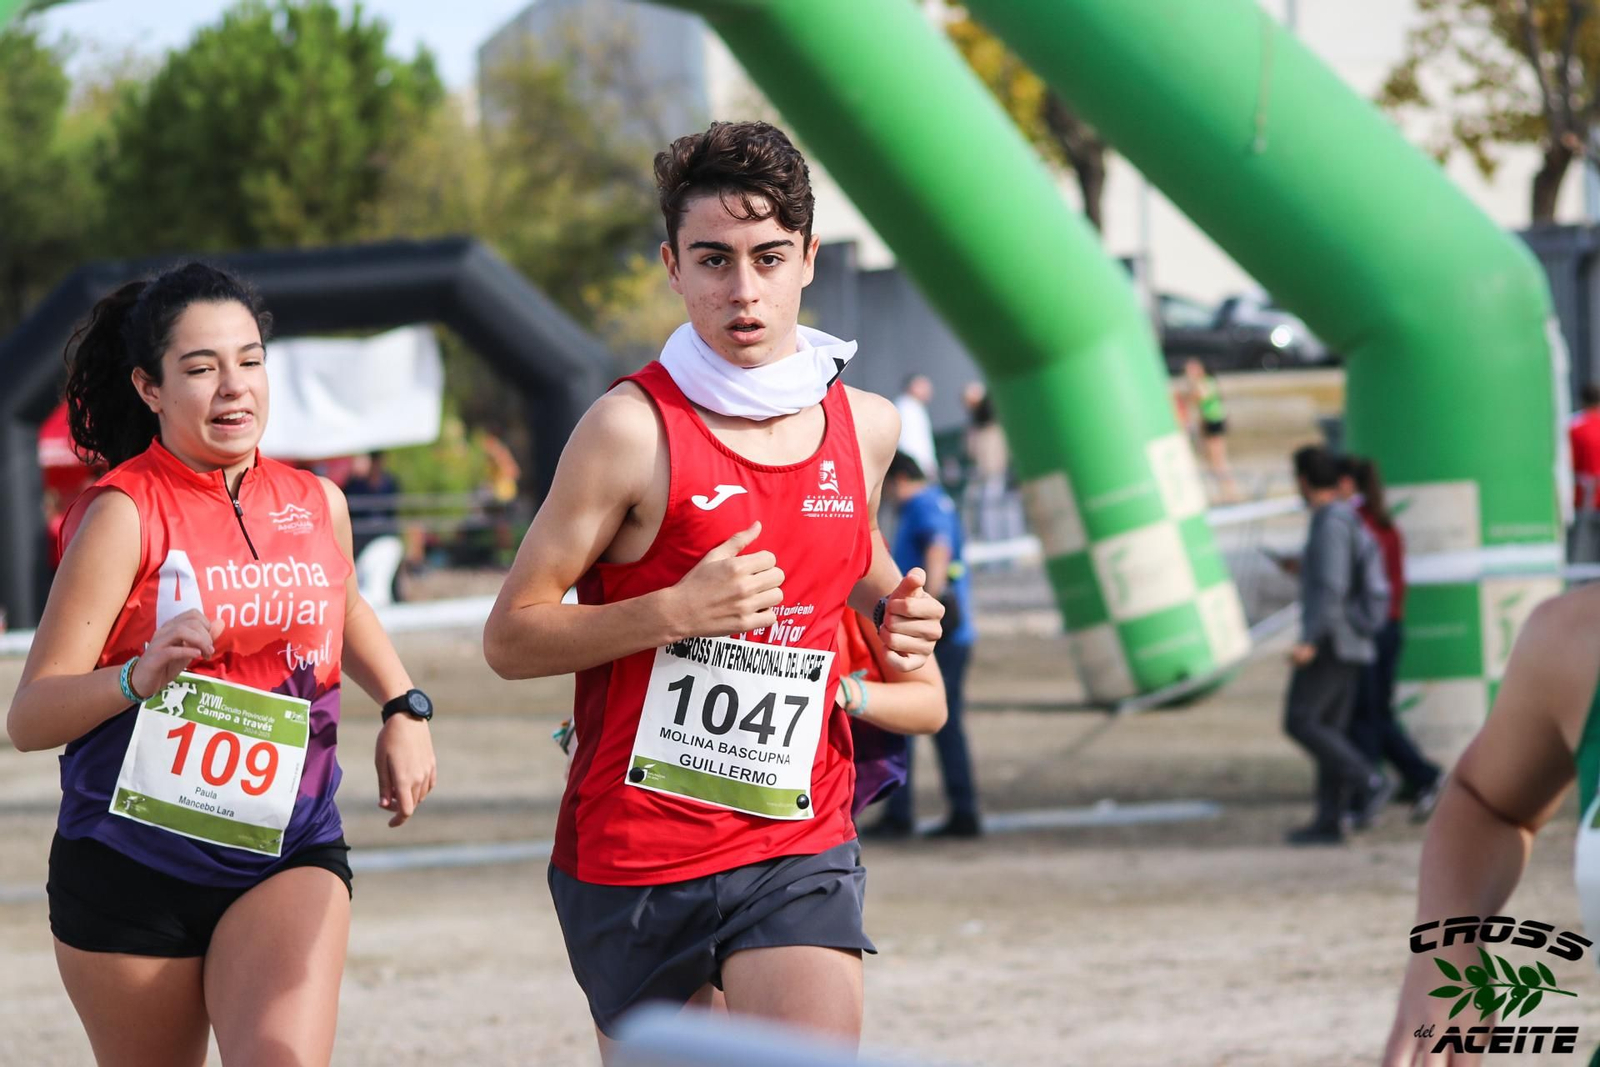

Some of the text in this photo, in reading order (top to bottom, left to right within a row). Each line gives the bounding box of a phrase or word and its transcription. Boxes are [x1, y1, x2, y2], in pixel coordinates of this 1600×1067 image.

[801, 499, 854, 512] SAYMA
[277, 629, 332, 671] trail
[711, 641, 783, 677] INTERNACIONAL
[785, 652, 799, 679] DEL
[199, 692, 223, 710] XXVII
[668, 674, 810, 748] 1047
[197, 705, 273, 732] Campo a través
[167, 721, 279, 796] 109
[660, 727, 791, 765] MOLINA BASCUPNA
[679, 753, 777, 786] GUILLERMO
[178, 795, 235, 818] Mancebo Lara
[195, 786, 218, 800] Paula
